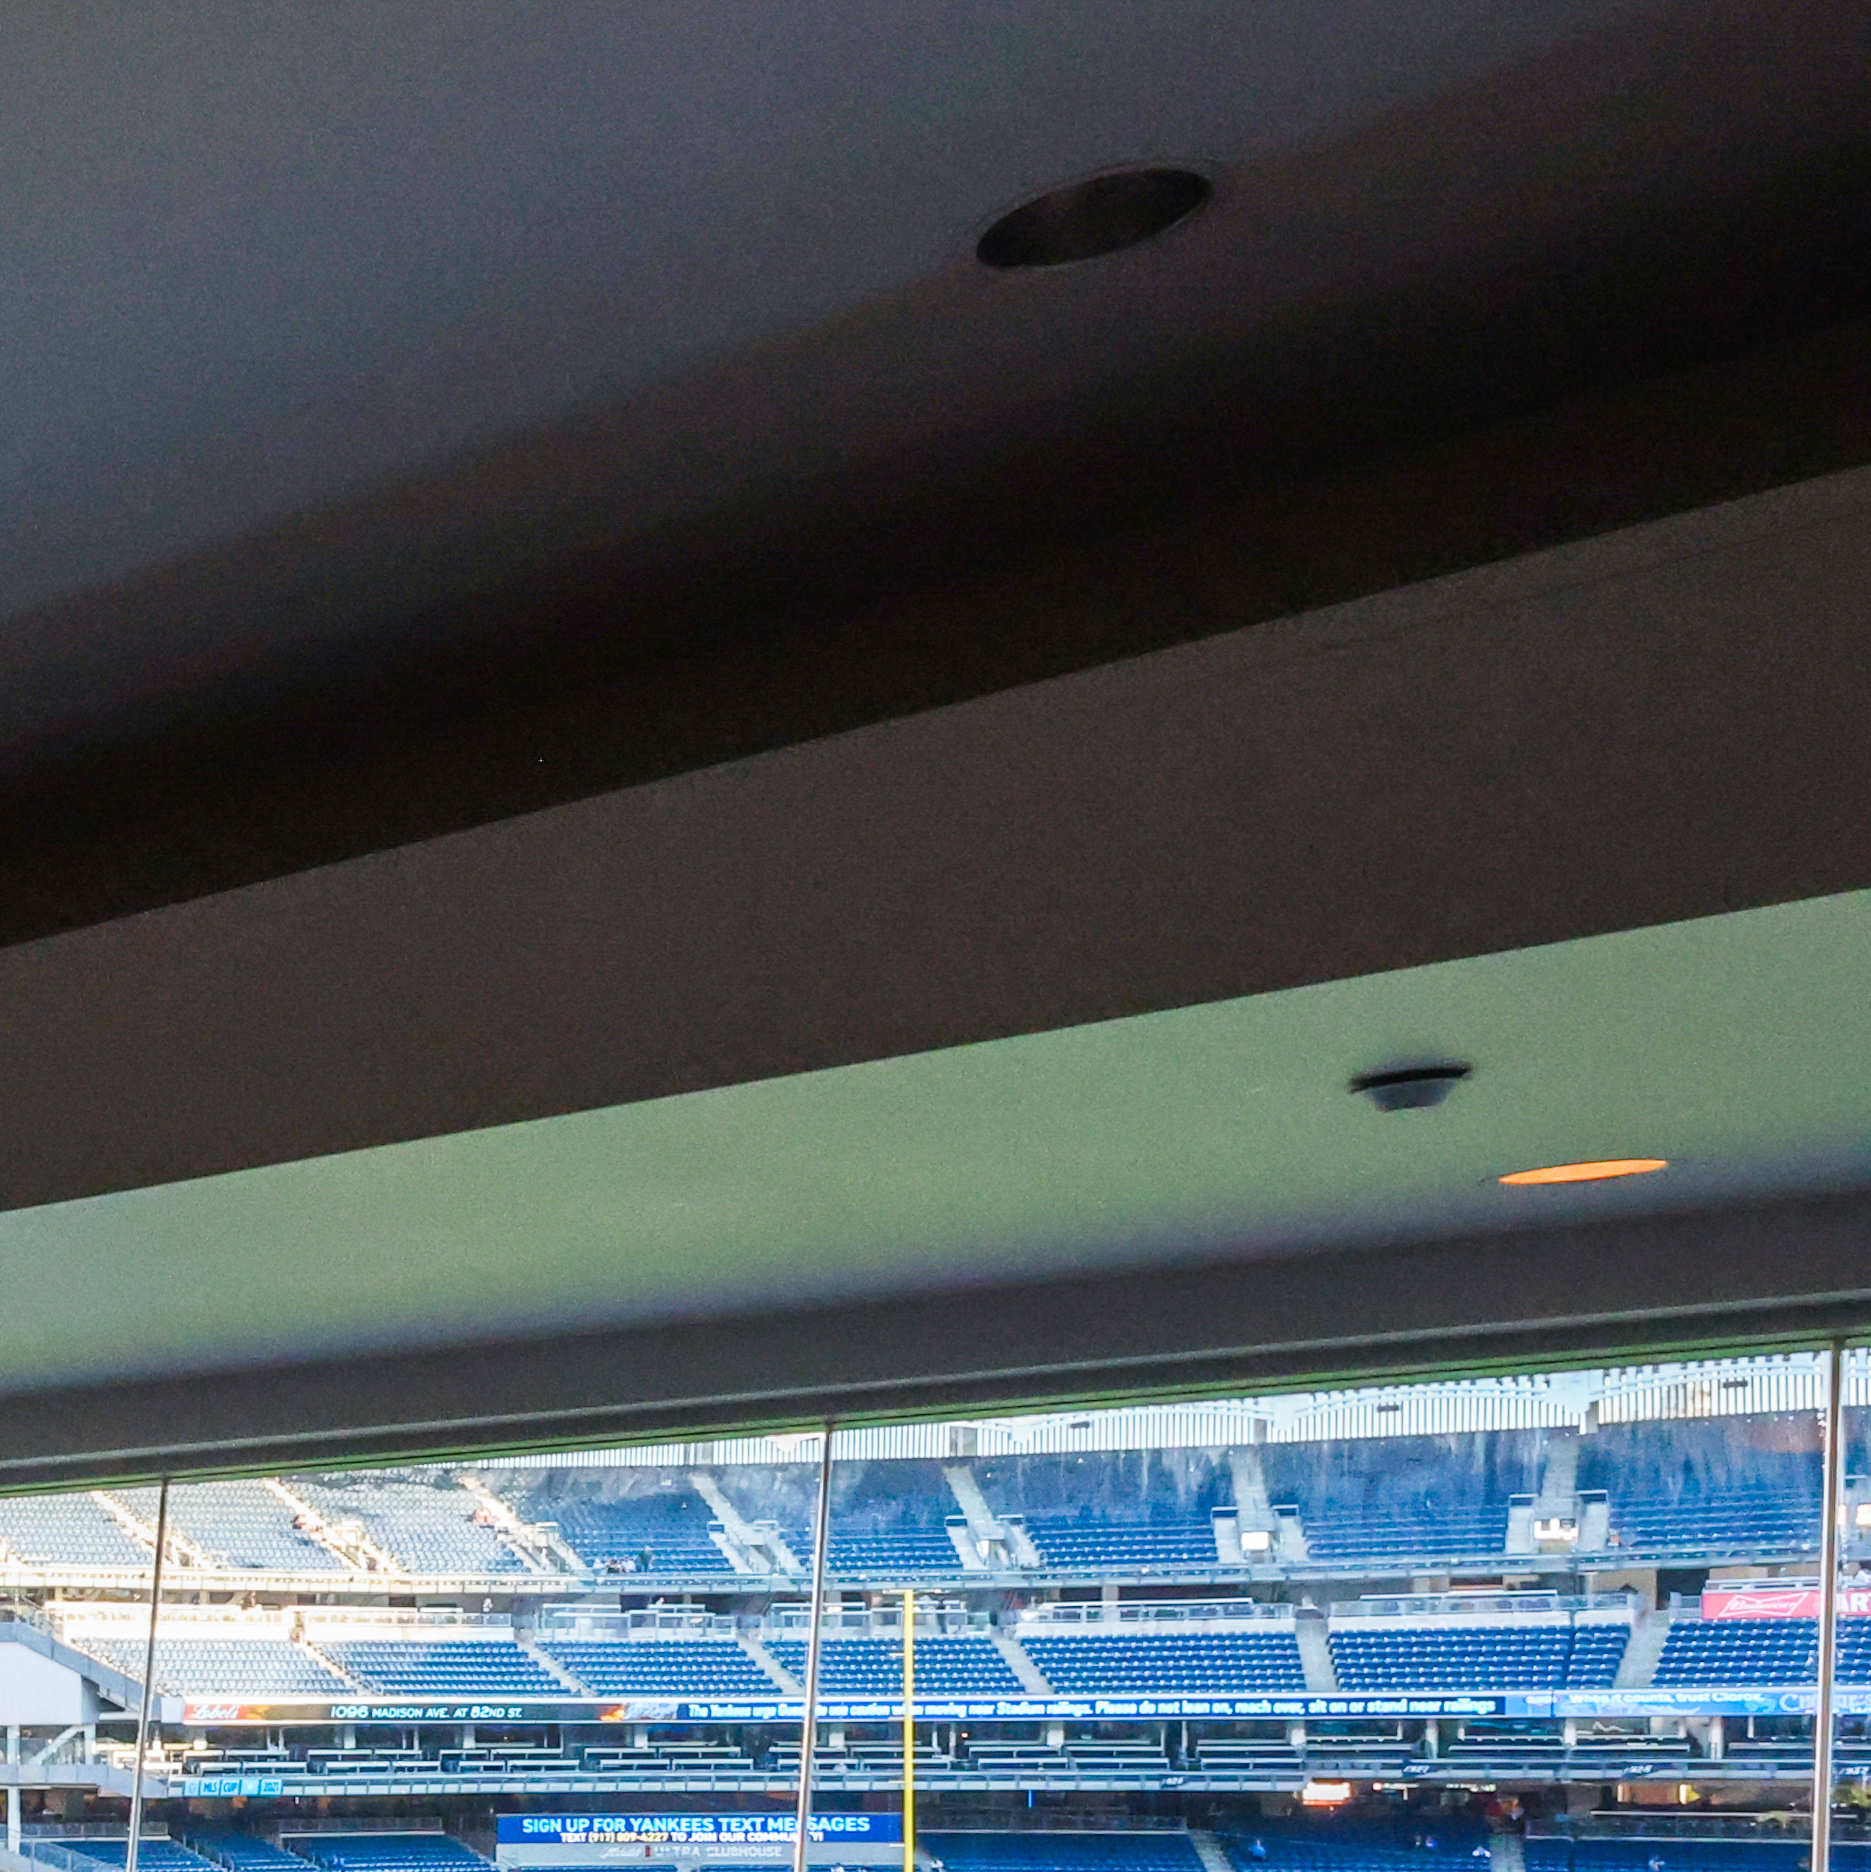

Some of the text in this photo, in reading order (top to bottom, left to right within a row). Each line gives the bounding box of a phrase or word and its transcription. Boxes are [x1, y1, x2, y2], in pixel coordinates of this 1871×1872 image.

[1623, 1694, 1675, 1705] counts,
[1675, 1693, 1710, 1703] trust
[330, 1705, 523, 1719] 1096 MADISON AVE. AT 82ND ST.
[688, 1704, 708, 1718] The
[709, 1704, 751, 1718] Yankees
[850, 1703, 890, 1717] caution
[924, 1703, 967, 1719] moving
[968, 1705, 995, 1716] near
[996, 1702, 1046, 1716] Stadium
[1095, 1701, 1138, 1715] Please
[1139, 1701, 1156, 1715] do
[1157, 1701, 1180, 1715] not
[1181, 1700, 1210, 1714] lean
[1308, 1700, 1328, 1713] sit
[1329, 1702, 1348, 1713] on
[1348, 1702, 1366, 1713] or
[1366, 1699, 1408, 1713] stand
[1409, 1701, 1442, 1713] near
[1443, 1698, 1496, 1714] railings
[203, 1781, 218, 1794] MLS
[223, 1781, 238, 1793] CUP
[522, 1816, 871, 1833] SIGN UP FOR YANKEES TEXT MESAGES
[560, 1832, 588, 1843] TEXT
[588, 1832, 615, 1843] (917)
[670, 1832, 687, 1842] TO
[688, 1832, 717, 1842] JOIN
[719, 1832, 745, 1842] OUR
